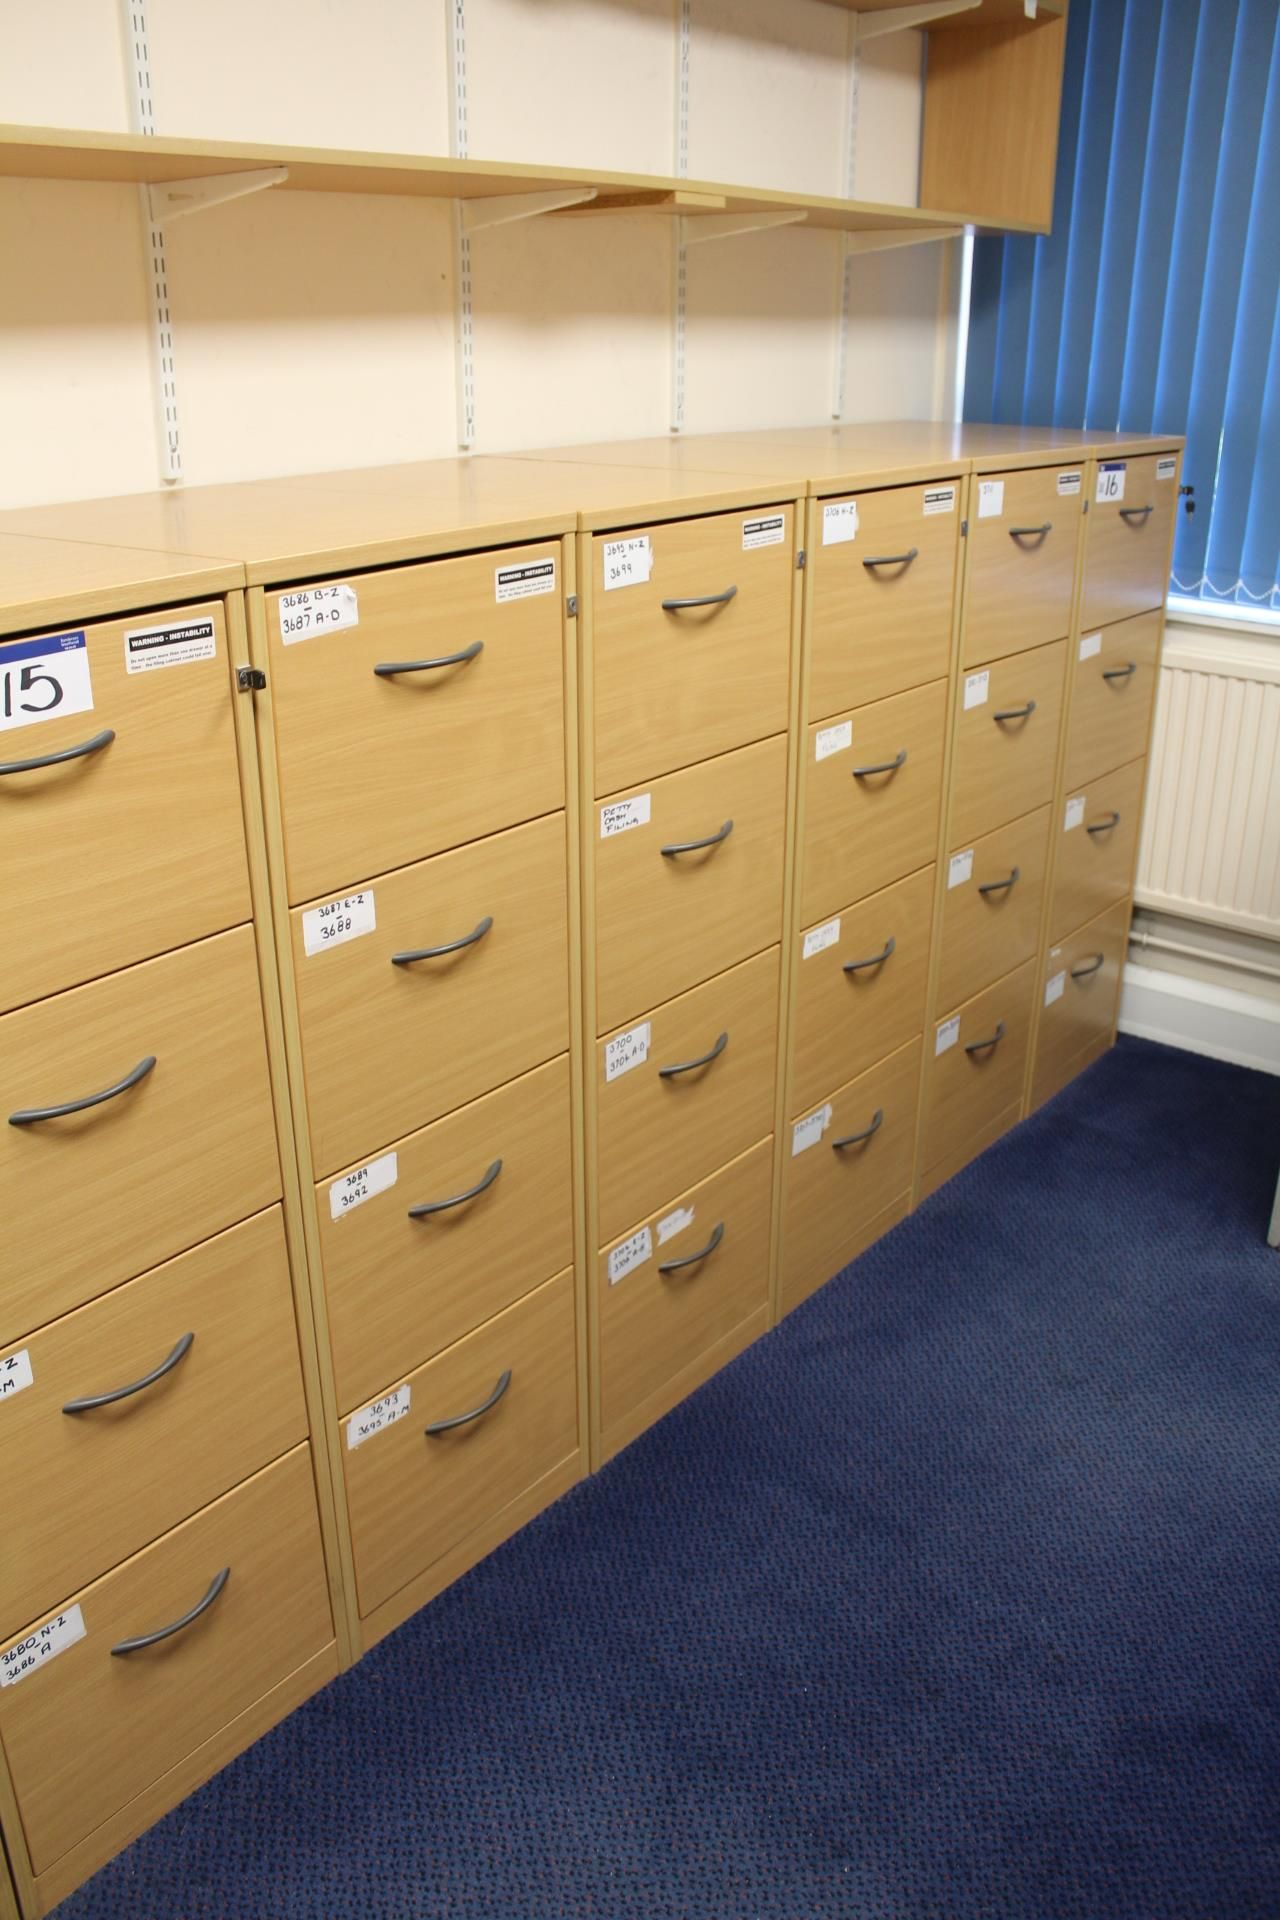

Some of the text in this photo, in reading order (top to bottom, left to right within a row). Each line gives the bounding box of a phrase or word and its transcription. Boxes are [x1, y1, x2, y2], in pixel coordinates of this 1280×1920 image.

[1105, 474, 1118, 496] 16
[610, 564, 632, 580] 3699
[282, 592, 309, 608] 3686
[283, 614, 310, 634] 3687
[130, 635, 165, 648] WARNING
[169, 626, 211, 641] INSTABILITY
[4, 664, 64, 717] 15
[318, 902, 340, 918] 3687
[320, 918, 352, 939] 3688
[610, 1034, 632, 1054] 3700
[346, 1168, 368, 1186] 3689
[341, 1185, 368, 1206] 3692
[370, 1394, 398, 1416] 3693
[1, 1636, 36, 1664] 3680
[6, 1642, 51, 1680] 3686 A
